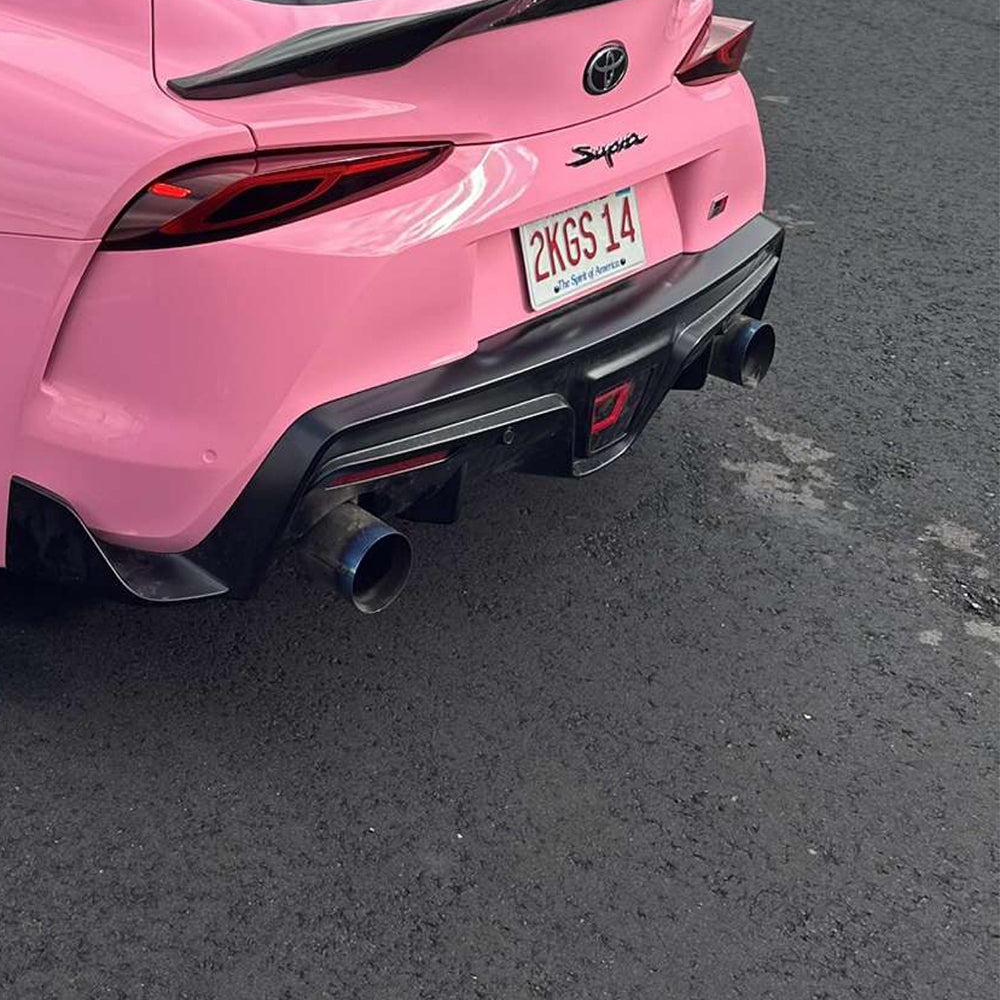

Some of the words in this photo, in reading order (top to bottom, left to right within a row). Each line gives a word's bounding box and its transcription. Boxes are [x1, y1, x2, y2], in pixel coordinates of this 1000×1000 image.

[565, 132, 648, 168] Supra
[530, 210, 598, 283] 2KGS
[601, 196, 636, 253] 14
[558, 279, 570, 289] The
[571, 271, 587, 286] Spirit
[595, 260, 620, 275] America
